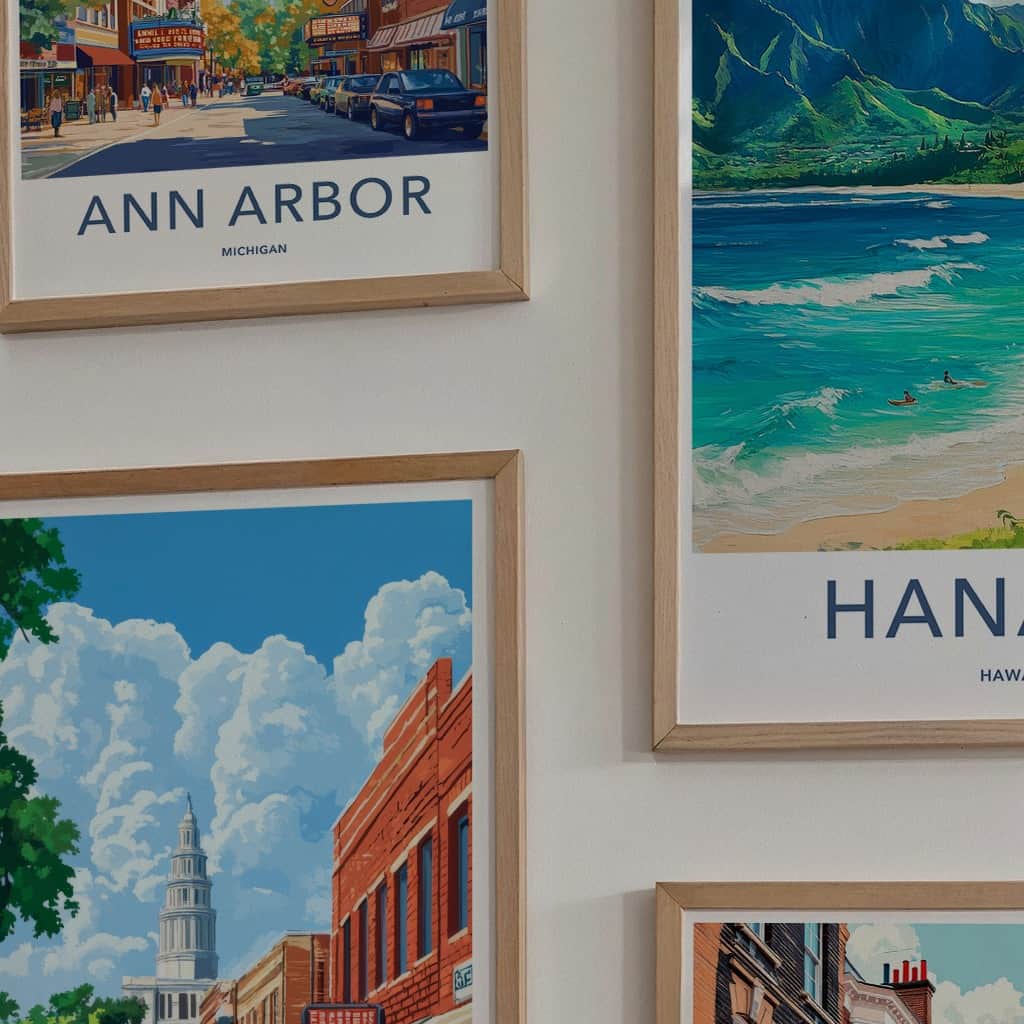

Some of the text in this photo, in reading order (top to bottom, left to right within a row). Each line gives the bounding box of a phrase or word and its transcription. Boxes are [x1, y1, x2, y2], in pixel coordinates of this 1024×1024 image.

[77, 175, 433, 236] ANN ARBOR
[221, 243, 288, 257] MICHIGAN
[827, 577, 1024, 640] HAN
[980, 668, 1024, 683] HAW
